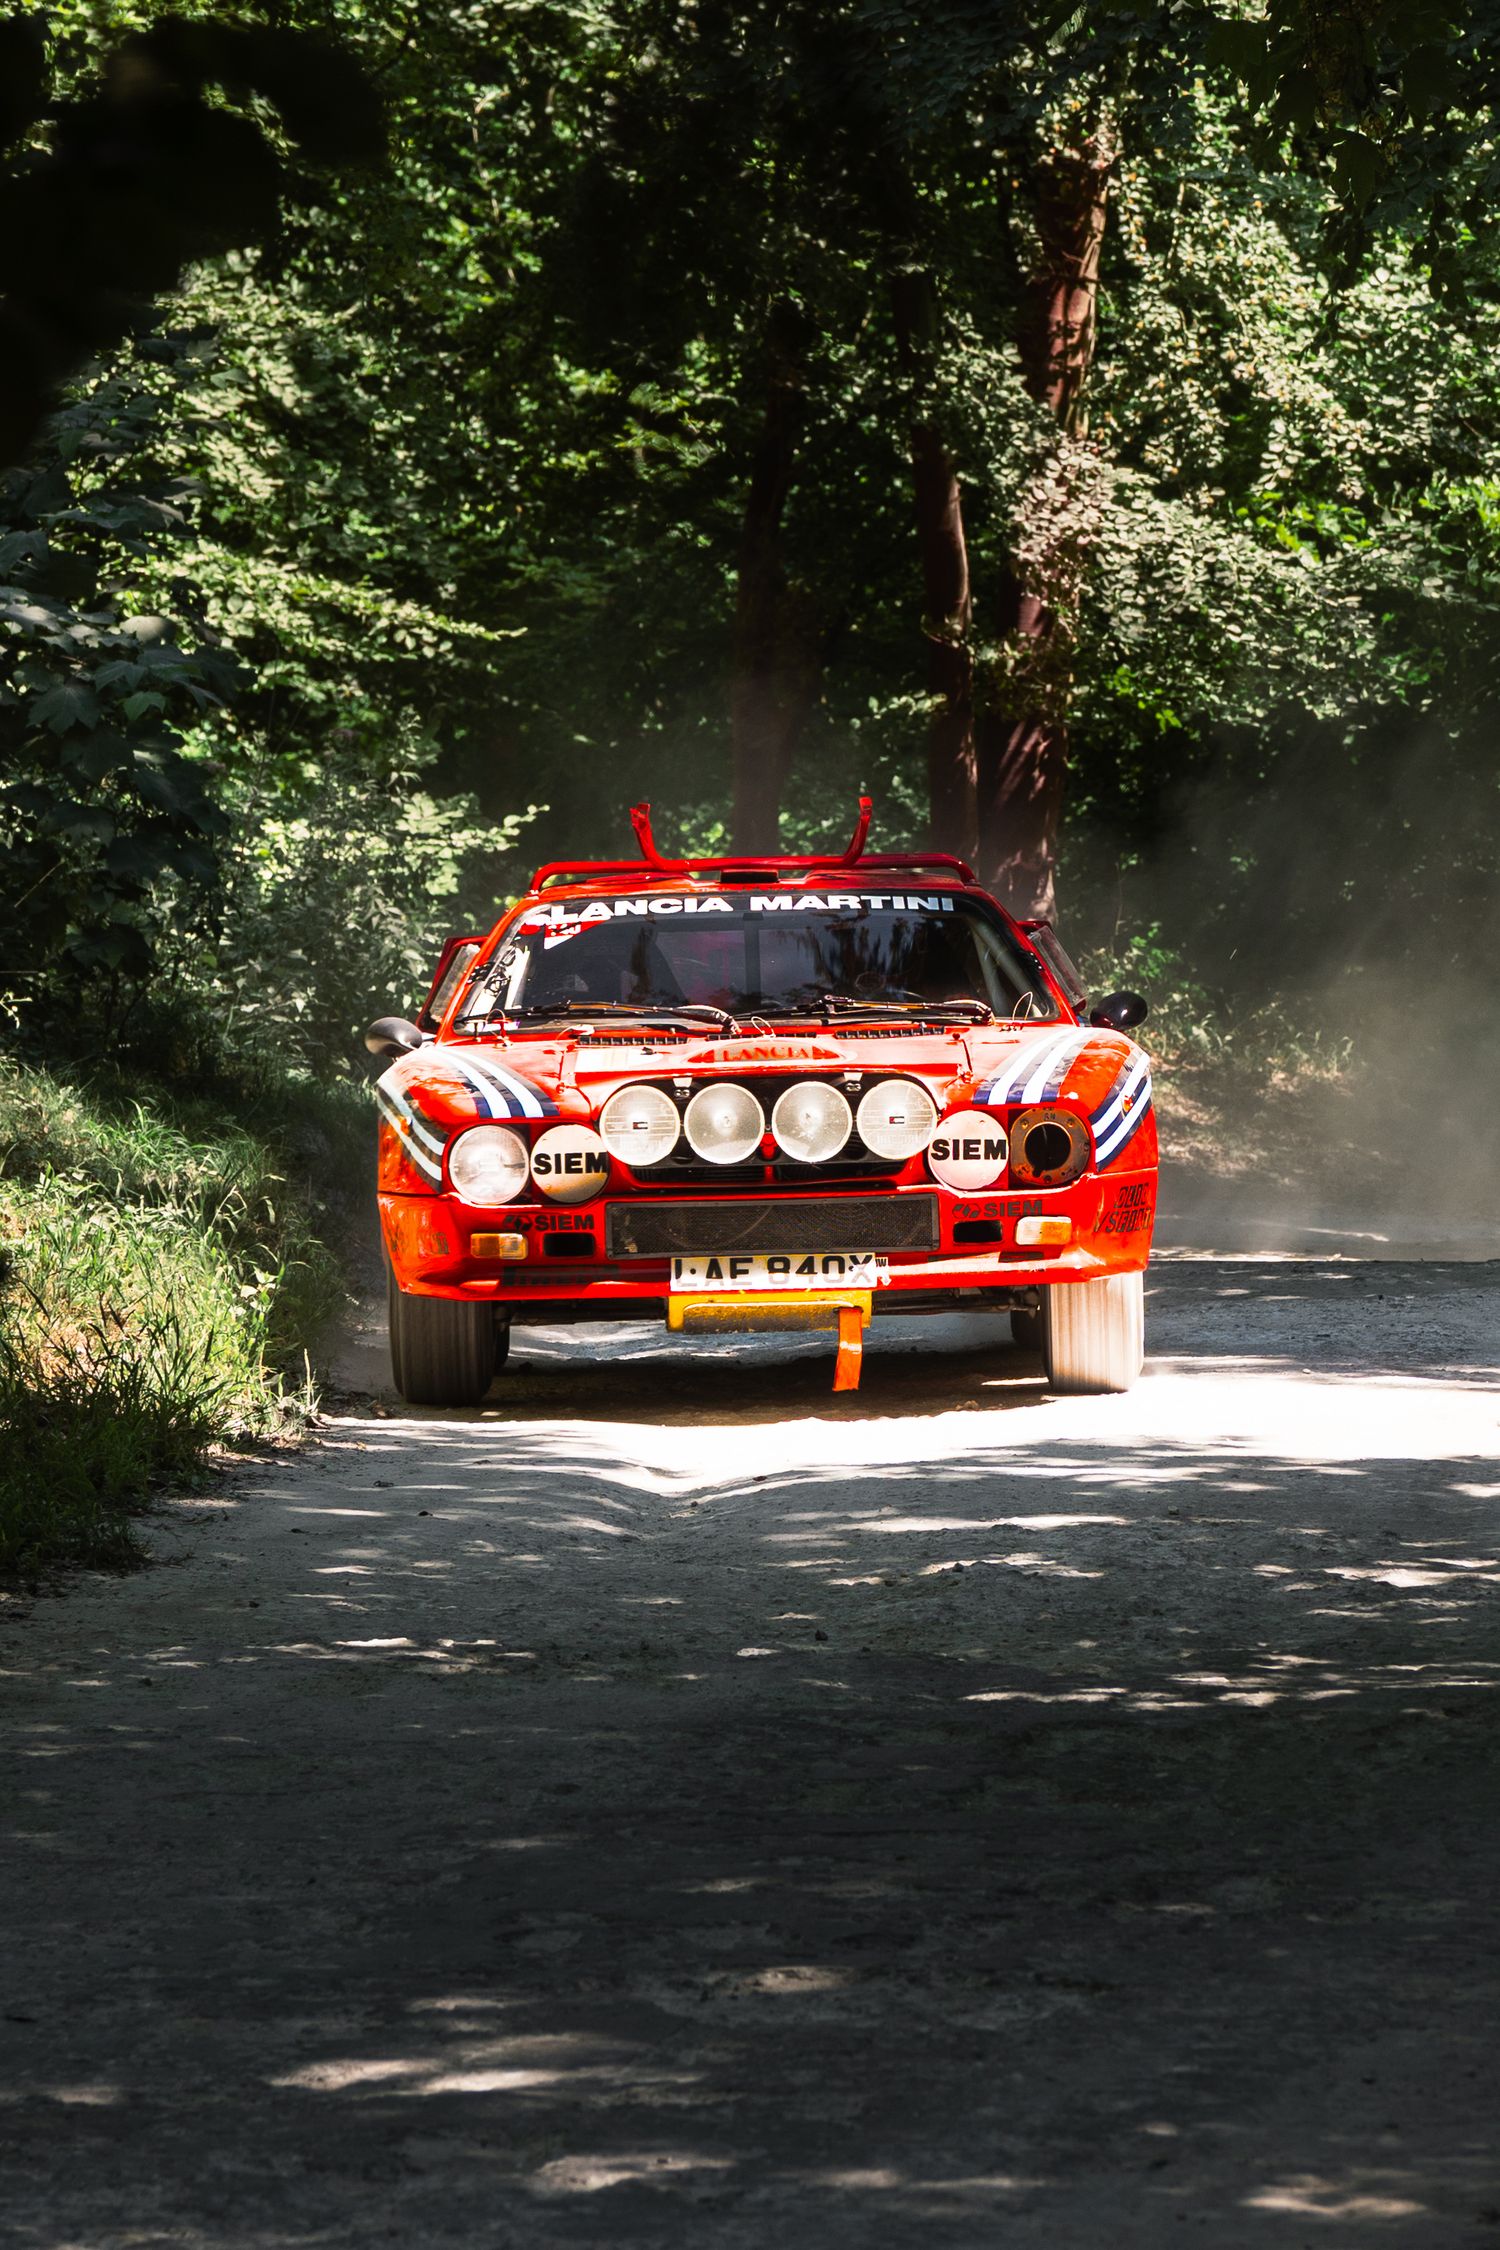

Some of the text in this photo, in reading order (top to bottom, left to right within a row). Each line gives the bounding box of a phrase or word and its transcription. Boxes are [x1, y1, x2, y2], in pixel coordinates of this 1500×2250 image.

[550, 895, 955, 922] LANCIA MARTINI
[723, 1046, 809, 1062] LANCIA
[930, 1138, 1008, 1162] SIEM
[533, 1151, 608, 1176] SIEM
[983, 1200, 1043, 1218] SIEM
[534, 1214, 595, 1231] SIEM
[766, 1254, 874, 1285] 840X
